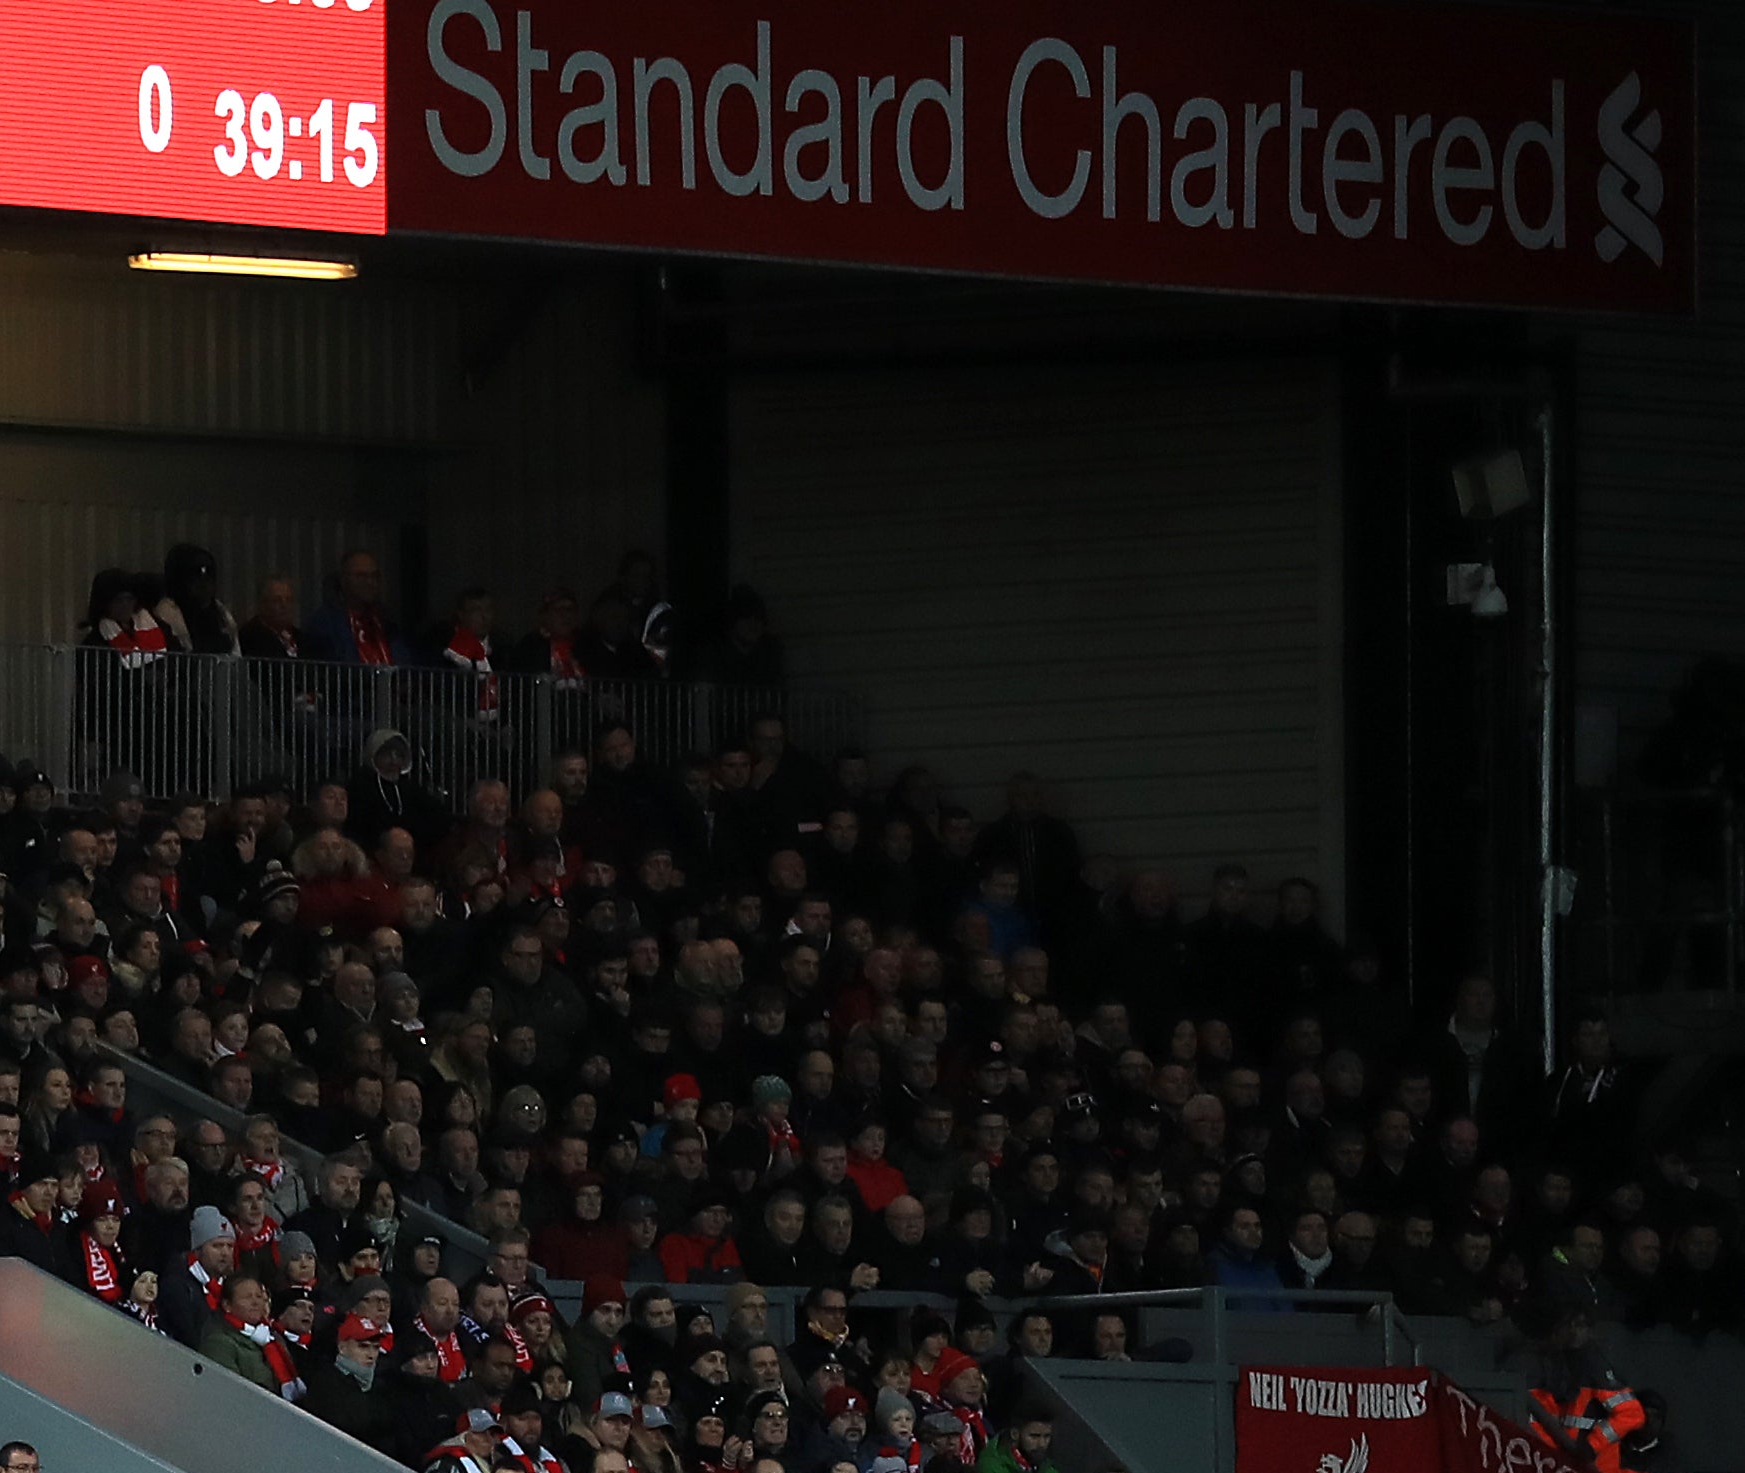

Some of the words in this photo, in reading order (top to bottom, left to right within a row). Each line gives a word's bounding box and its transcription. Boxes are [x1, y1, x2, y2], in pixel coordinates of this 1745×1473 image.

[138, 64, 173, 153] 0
[213, 89, 379, 188] 39:15
[425, 0, 964, 210] Standard
[1006, 37, 1566, 249] Chartered
[1249, 1372, 1288, 1412] NEIL
